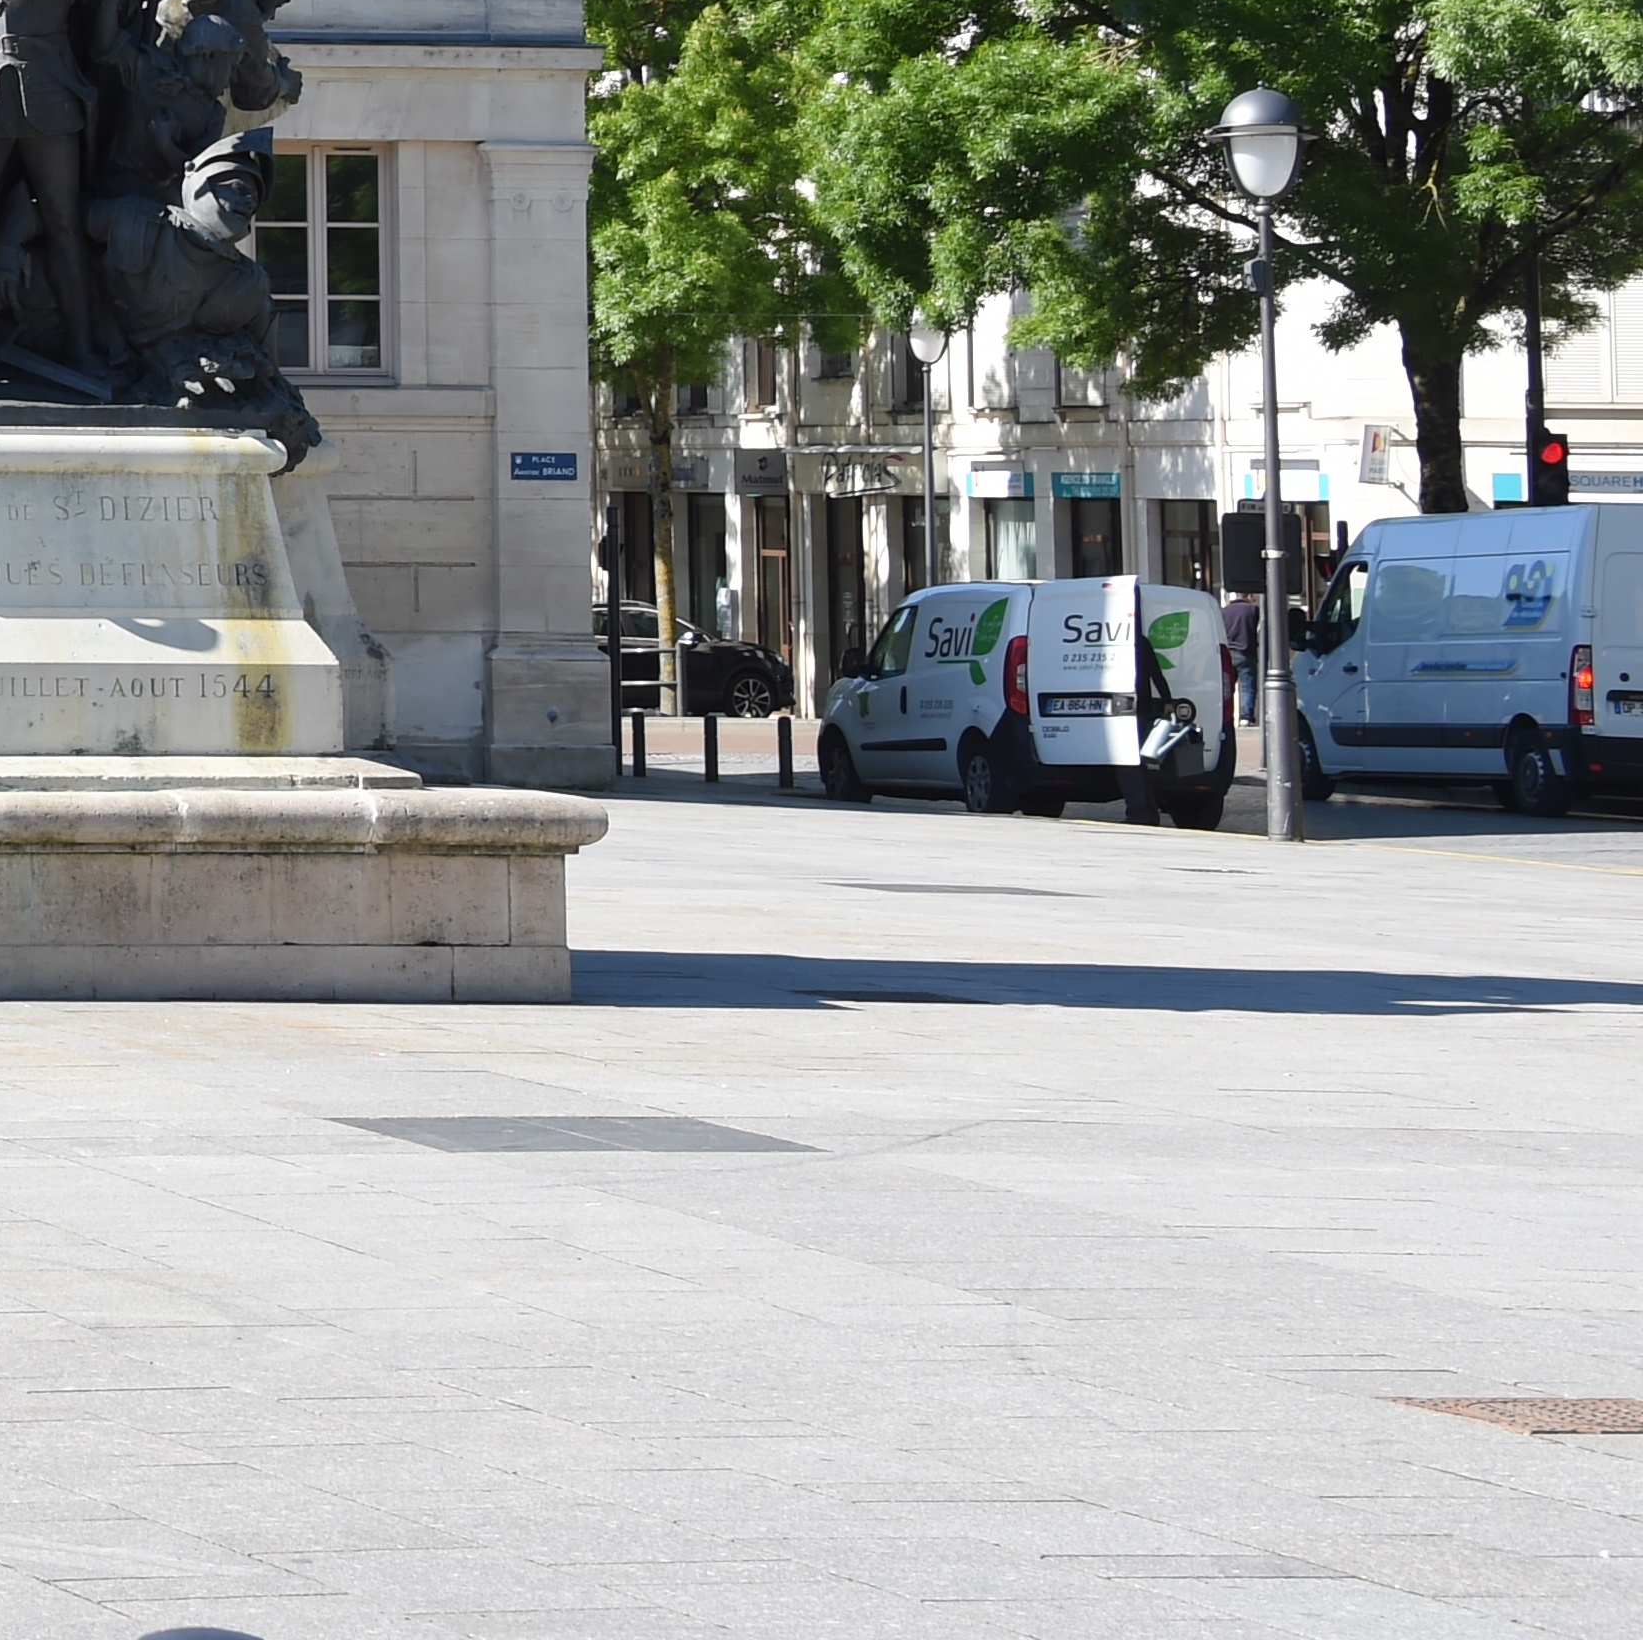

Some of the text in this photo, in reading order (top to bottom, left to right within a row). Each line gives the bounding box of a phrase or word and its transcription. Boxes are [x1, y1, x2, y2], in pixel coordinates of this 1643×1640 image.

[531, 456, 556, 464] PLACE
[542, 467, 575, 476] BRIAND
[741, 474, 784, 484] Matmut
[1570, 475, 1631, 488] SQUARE
[8, 504, 35, 521] DE
[99, 495, 220, 522] DIZIER
[924, 612, 976, 658] Savi
[1061, 612, 1133, 644] Savi
[199, 673, 277, 699] 1544
